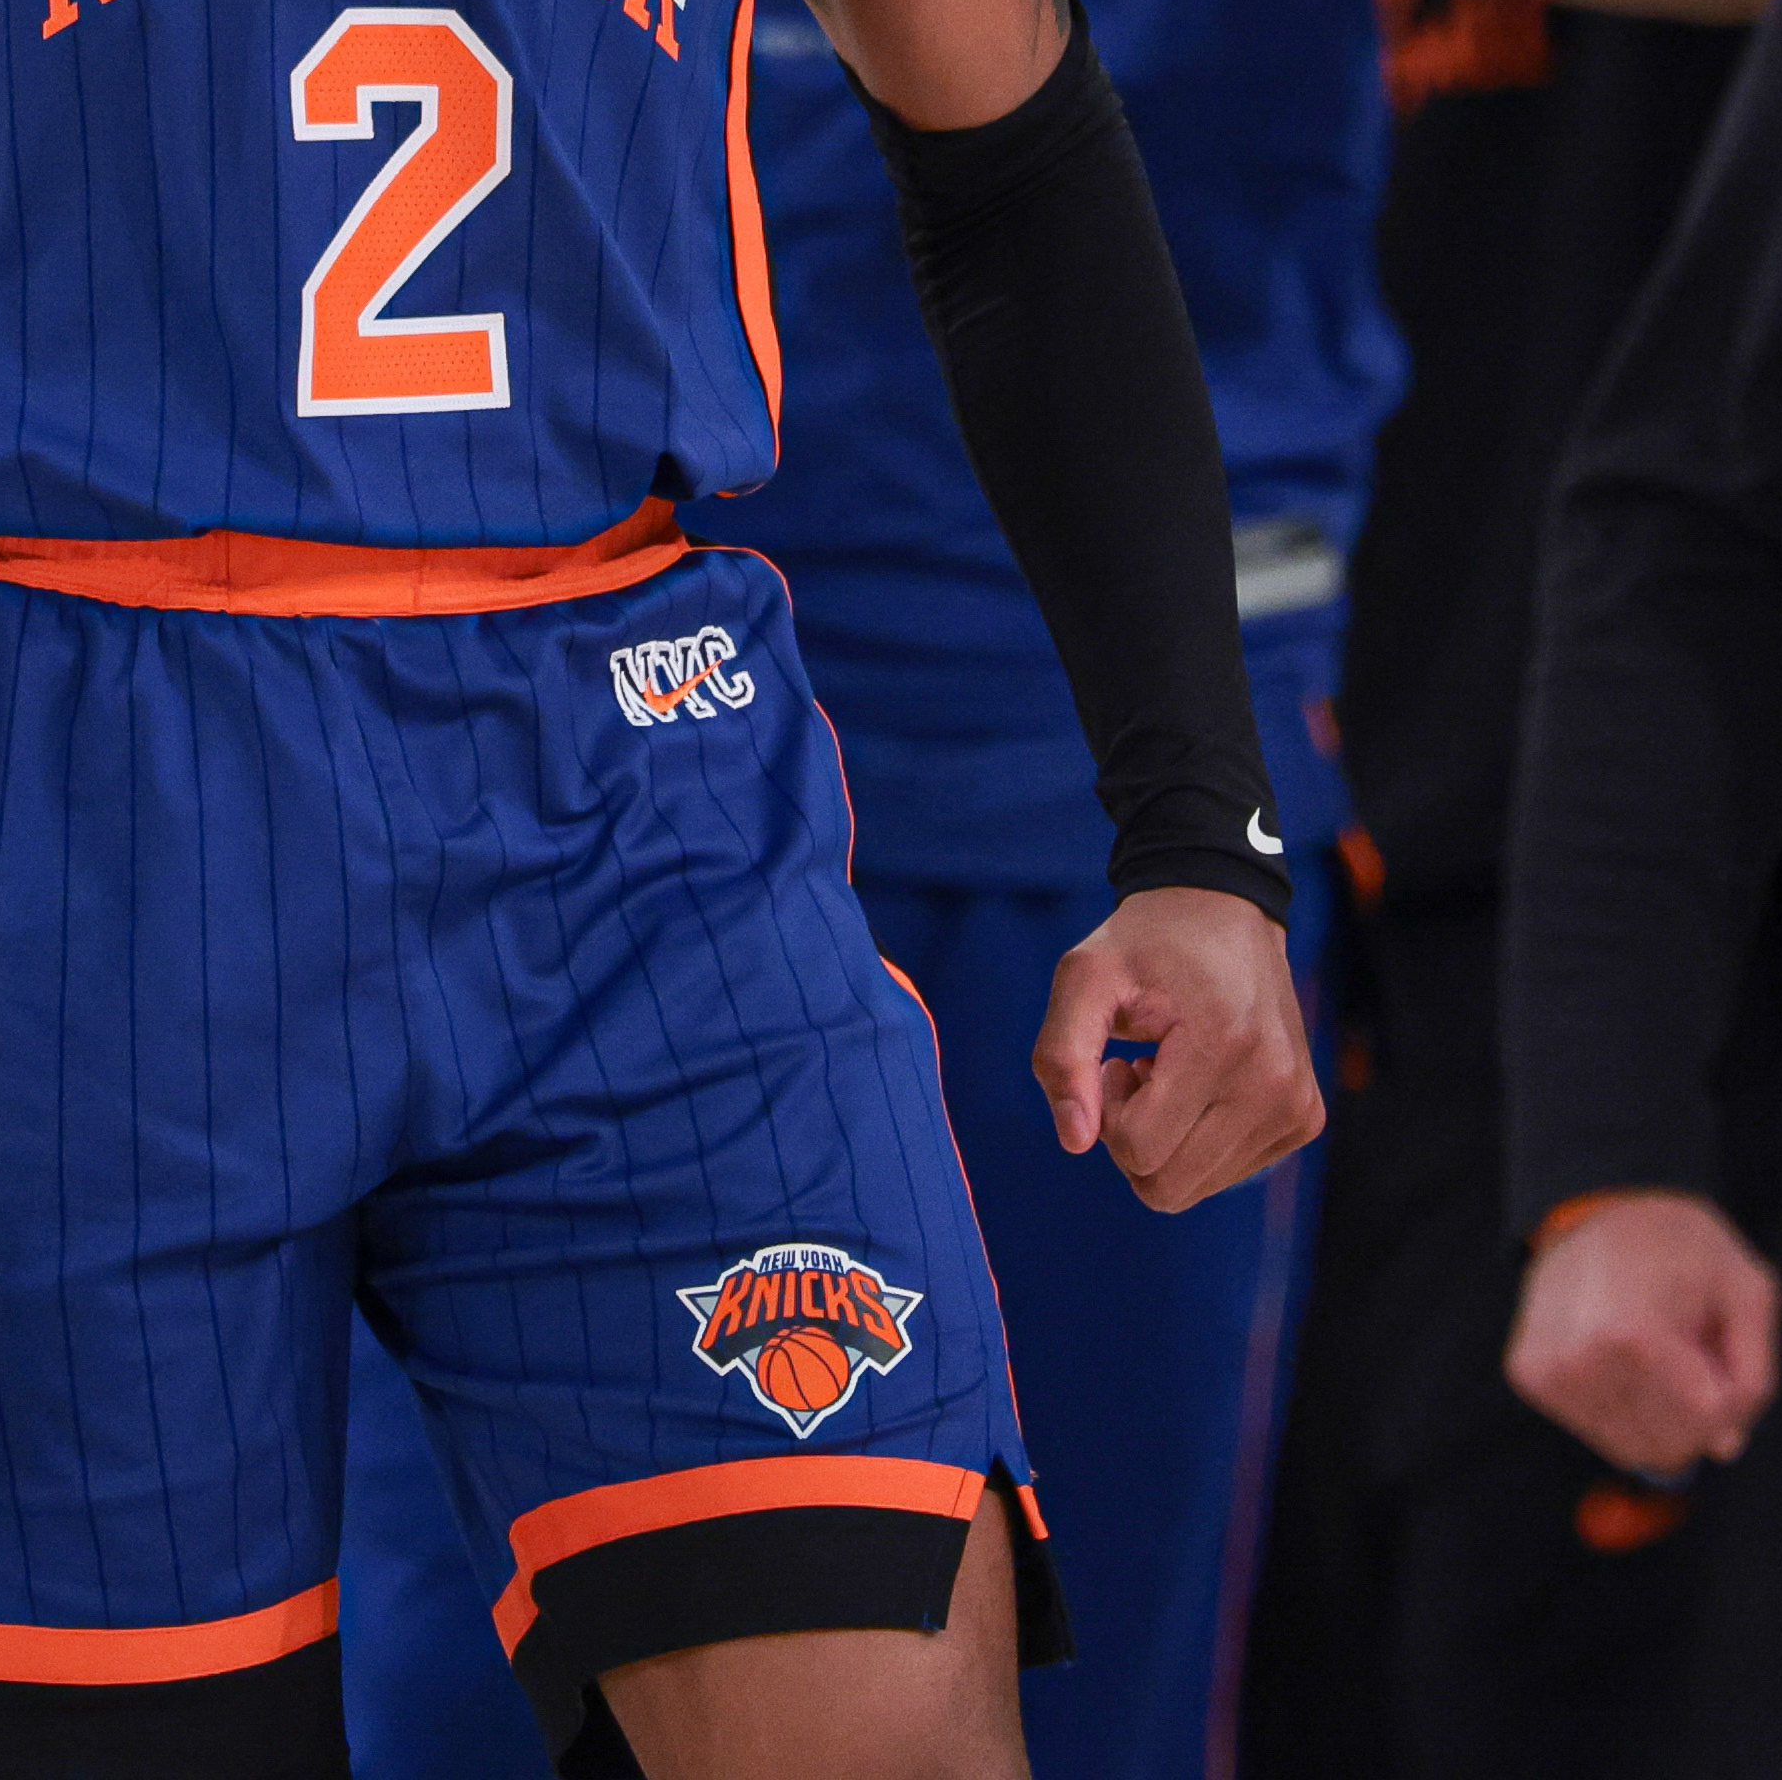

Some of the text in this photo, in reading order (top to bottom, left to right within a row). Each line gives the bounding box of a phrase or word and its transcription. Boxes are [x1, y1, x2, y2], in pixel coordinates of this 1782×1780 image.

[291, 7, 514, 417] 2
[610, 625, 756, 727] NYC
[759, 1249, 844, 1272] NEW YORK
[702, 1270, 903, 1350] KNICKS
